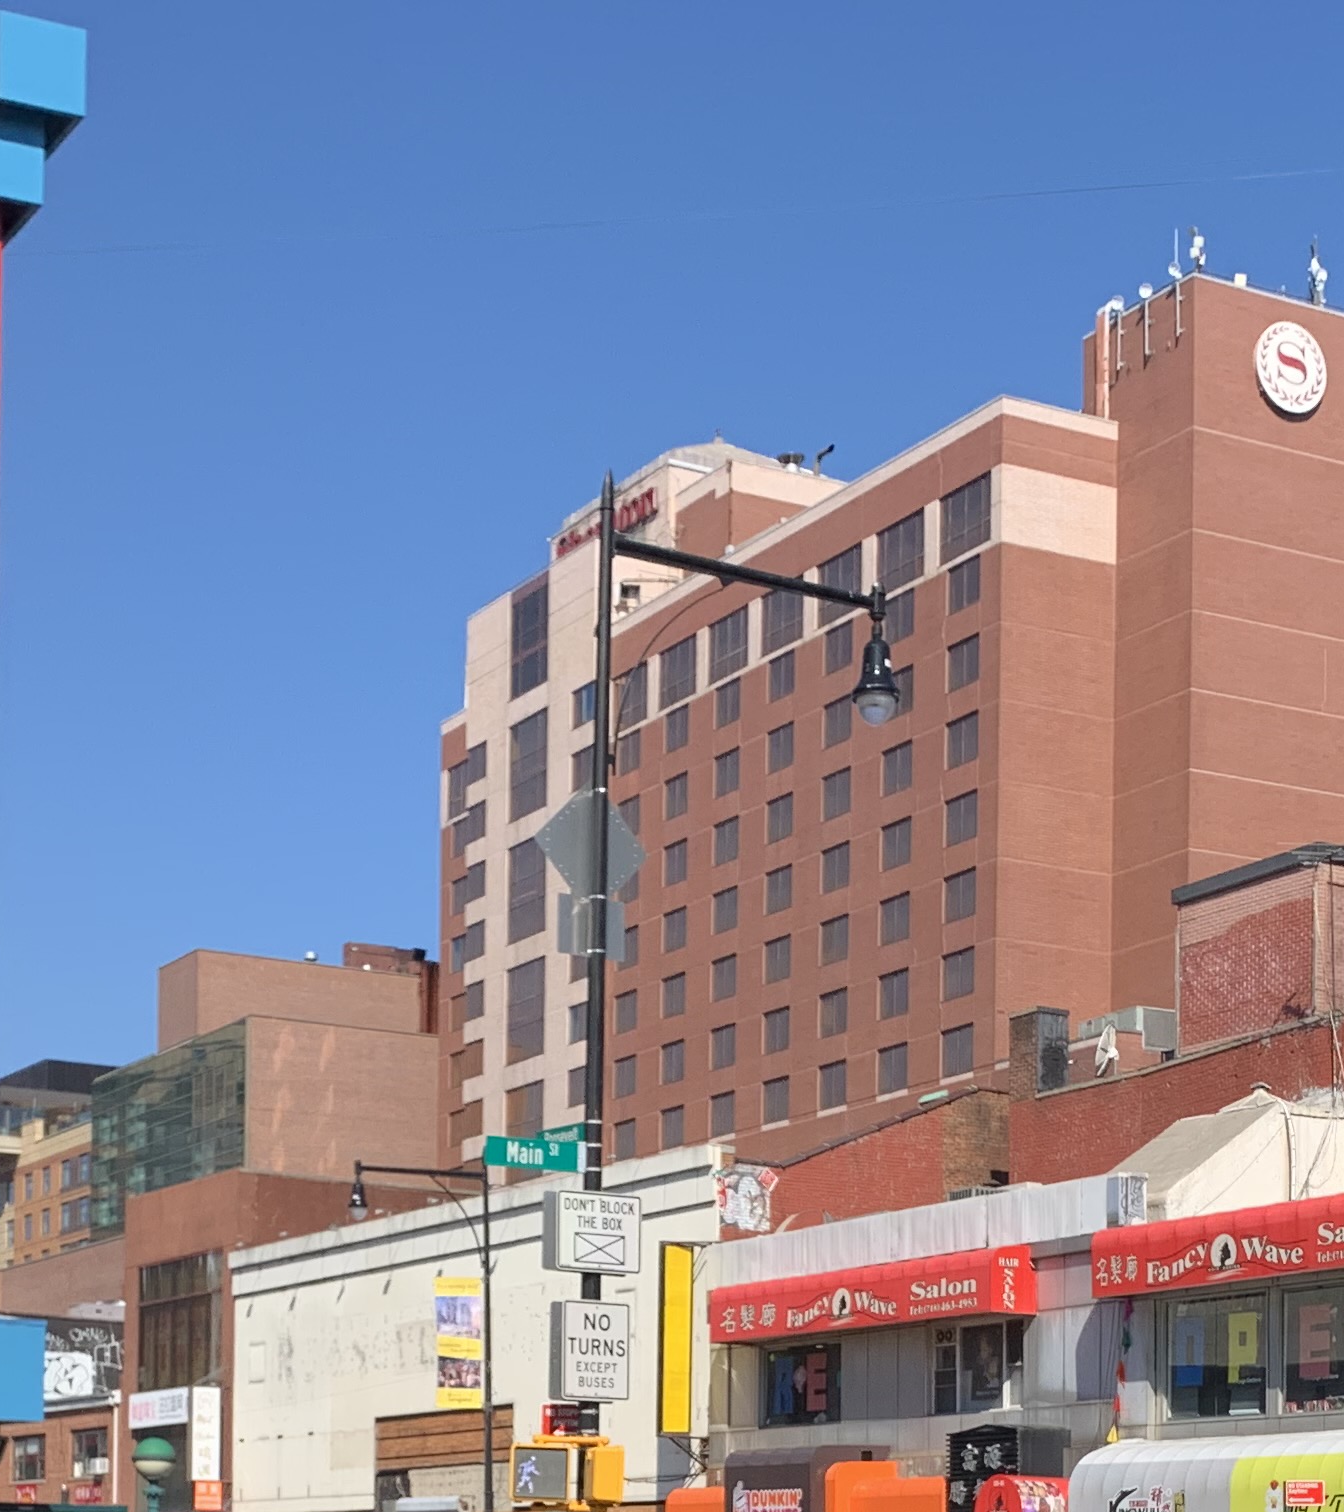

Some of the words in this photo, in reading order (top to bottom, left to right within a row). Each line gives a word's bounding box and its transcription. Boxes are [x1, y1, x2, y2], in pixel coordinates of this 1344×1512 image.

[506, 1140, 544, 1166] Main
[549, 1142, 560, 1157] St
[564, 1197, 596, 1213] DON'T
[600, 1199, 637, 1215] BLOCK
[577, 1215, 598, 1230] THE
[602, 1217, 623, 1231] BOX
[998, 1256, 1019, 1268] HAIR
[1146, 1242, 1209, 1285] Fancy
[1241, 1235, 1304, 1266] Wave
[909, 1277, 977, 1301] Salon
[1002, 1268, 1015, 1311] SALON
[786, 1294, 833, 1329] Fancy
[854, 1290, 897, 1316] Wave
[584, 1313, 611, 1331] NO
[567, 1337, 626, 1357] TURNS
[576, 1361, 618, 1374] EXCEPT
[578, 1376, 615, 1389] BUSES
[751, 1487, 803, 1507] DUNKIN'
